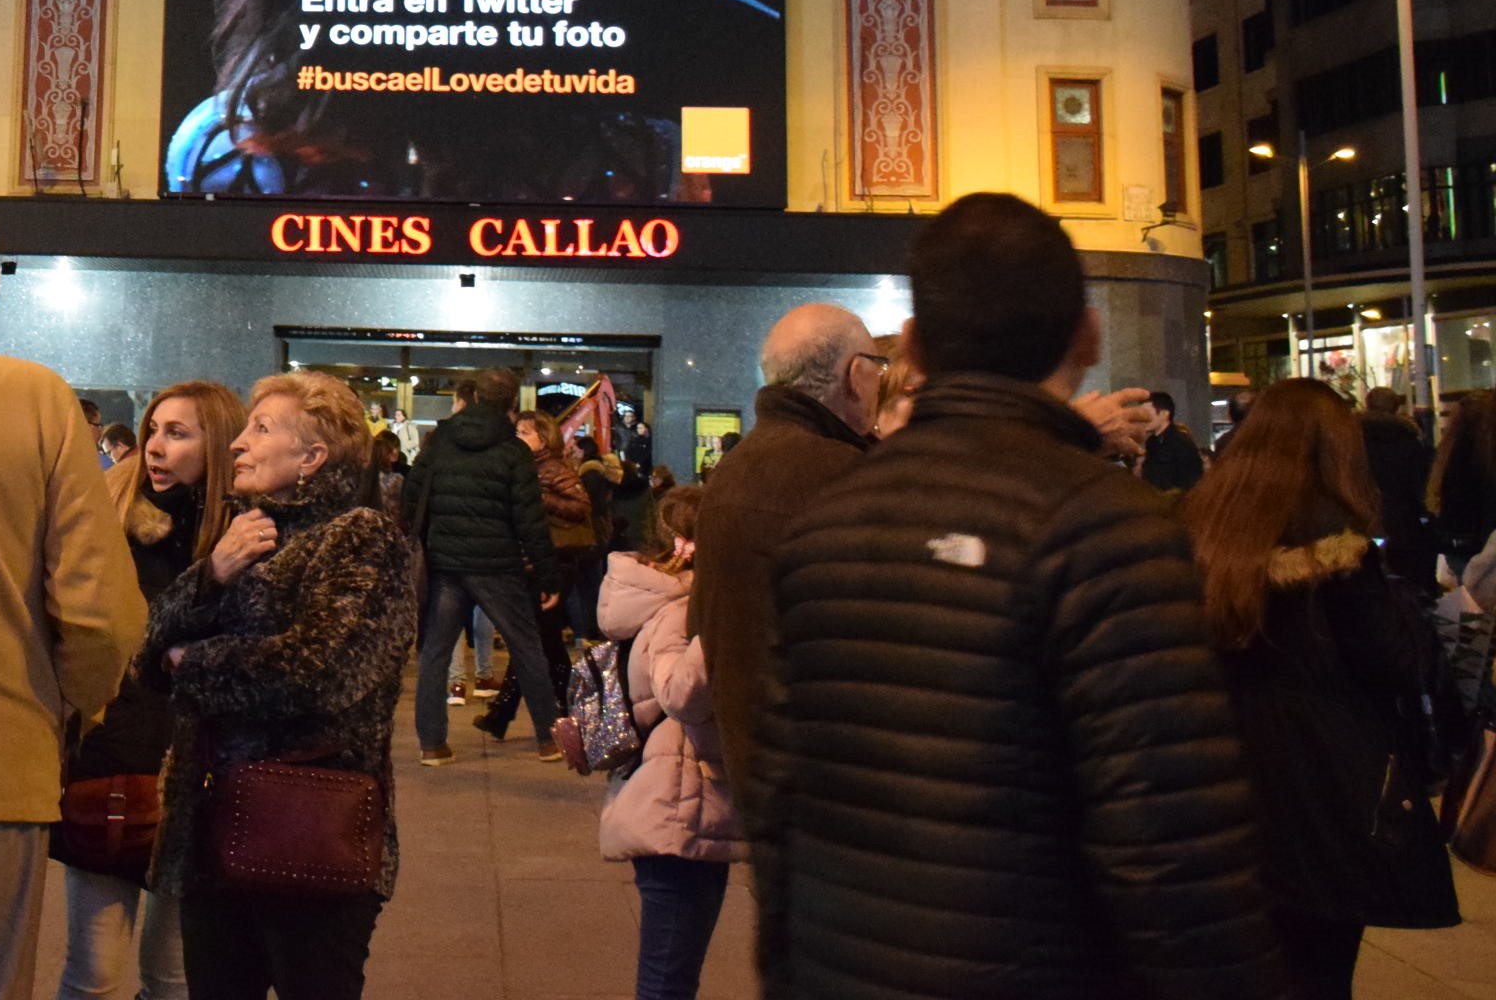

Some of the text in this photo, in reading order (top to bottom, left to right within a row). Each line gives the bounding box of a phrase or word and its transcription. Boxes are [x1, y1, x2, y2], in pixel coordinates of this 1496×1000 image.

[299, 20, 626, 51] y comparte tu foto
[297, 66, 636, 95] #buscaelLovedetuvida
[271, 213, 680, 258] CINES CALLAO
